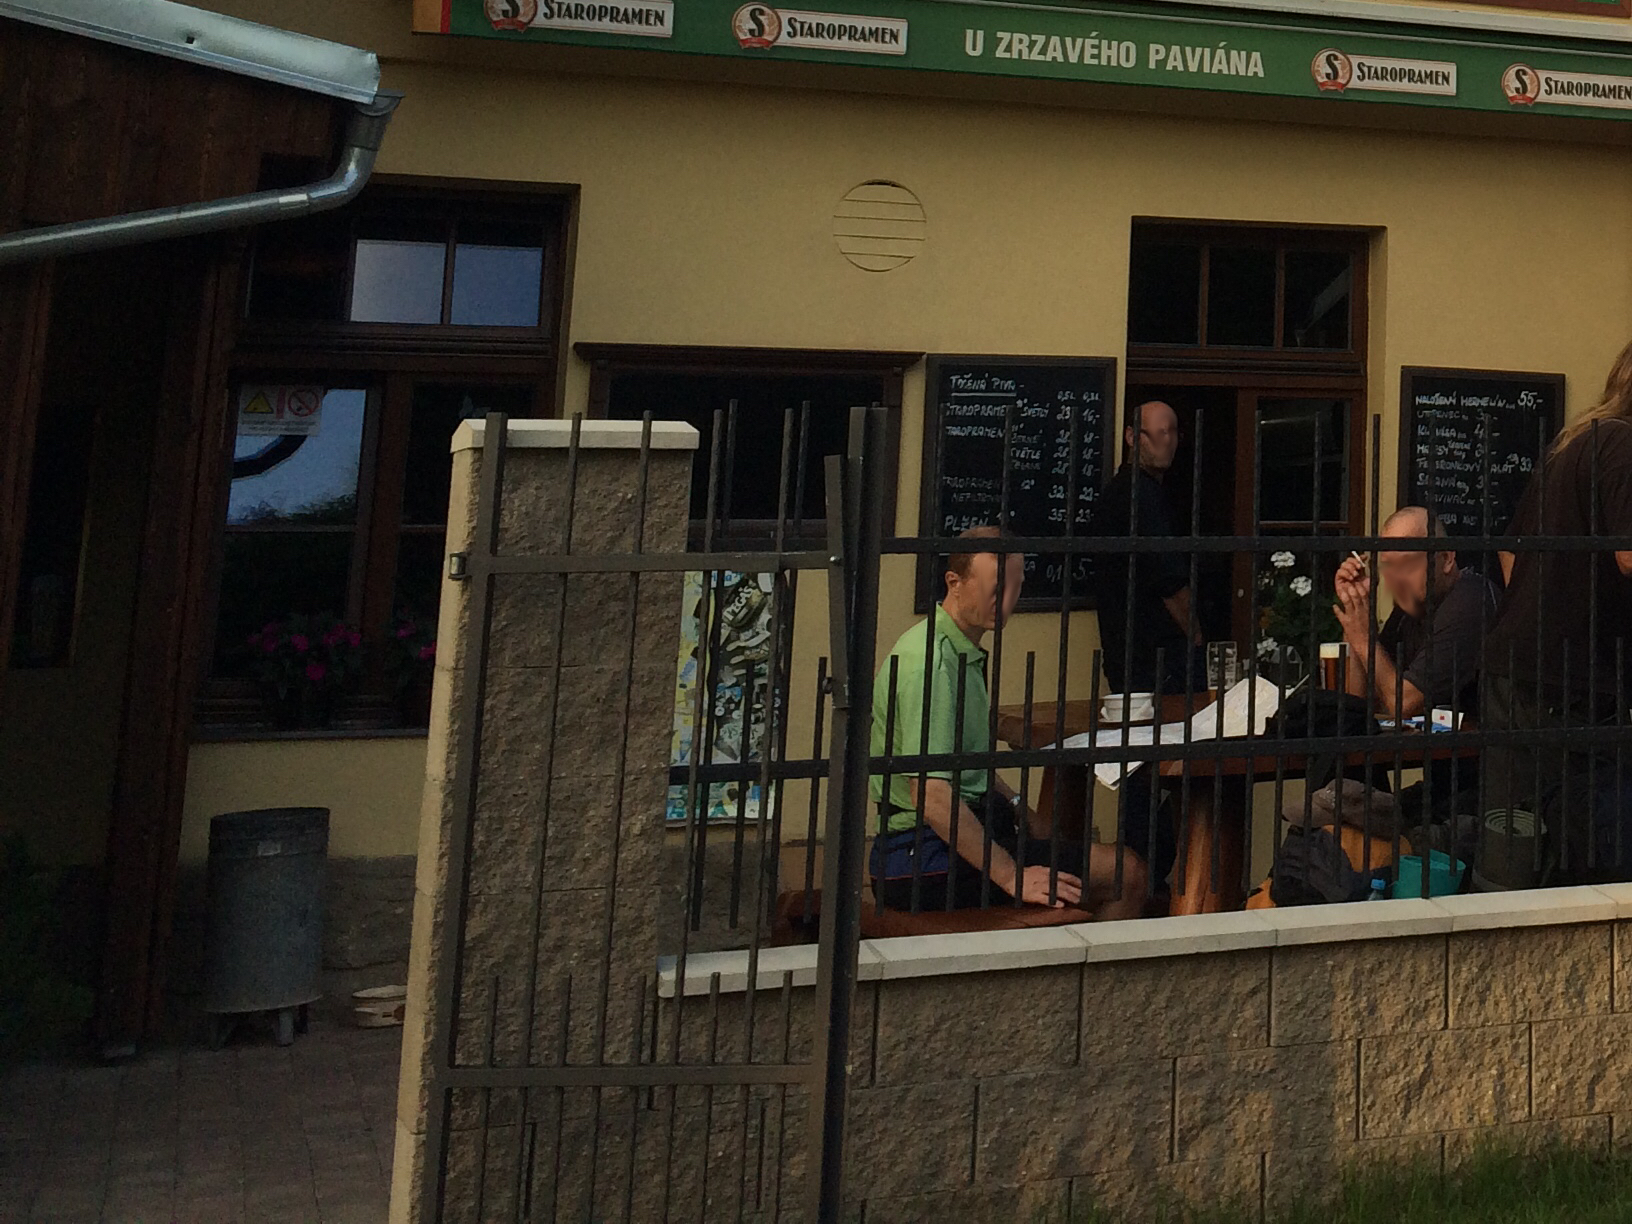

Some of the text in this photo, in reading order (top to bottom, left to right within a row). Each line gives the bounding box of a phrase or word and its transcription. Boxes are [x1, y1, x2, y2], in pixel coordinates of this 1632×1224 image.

[749, 8, 900, 45] S STAROPRAMEN
[965, 29, 1265, 77] U ZRZAVÉHO PAVIÁNA
[1325, 53, 1451, 87] S STAROPRAMEN
[1514, 68, 1623, 101] S STAROPRAMEN
[944, 425, 1007, 439] TAROPRAMEN
